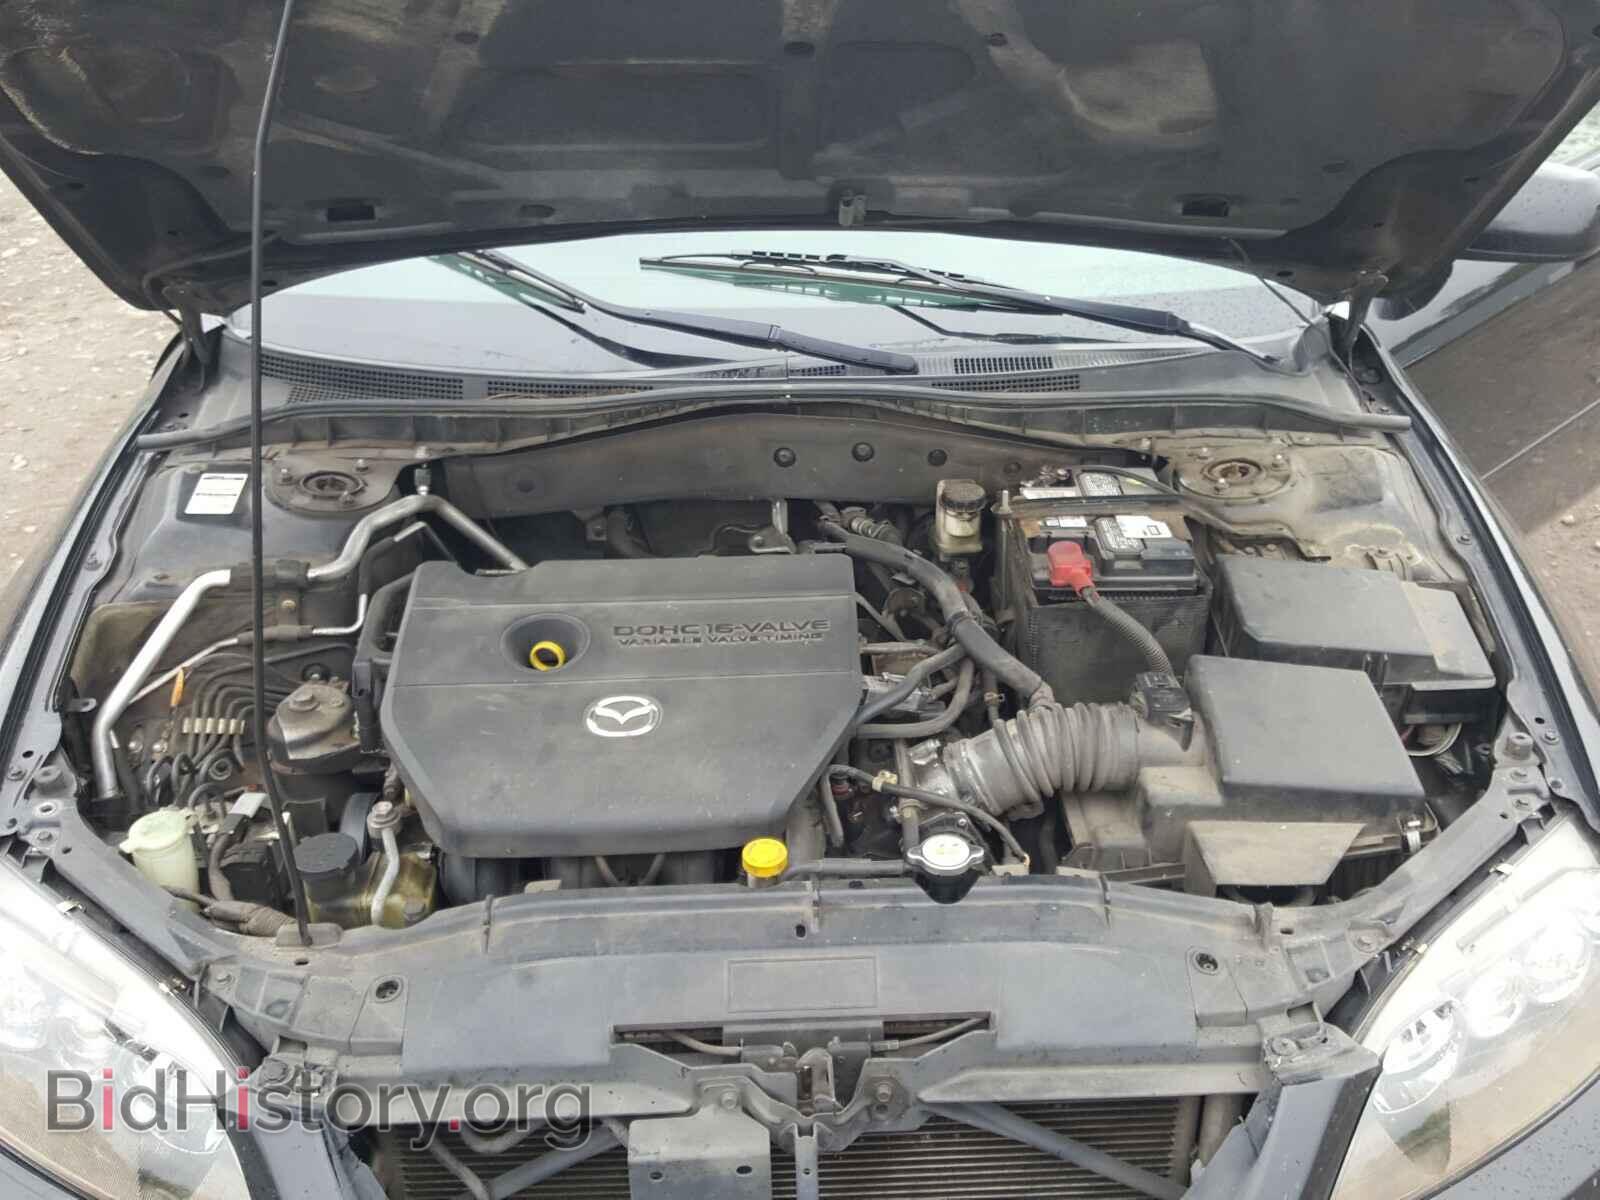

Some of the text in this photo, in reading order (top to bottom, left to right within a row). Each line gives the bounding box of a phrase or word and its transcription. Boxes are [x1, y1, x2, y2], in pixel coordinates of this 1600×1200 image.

[613, 624, 700, 636] DOHC
[619, 632, 823, 646] VARIABLE VALVE TIMING
